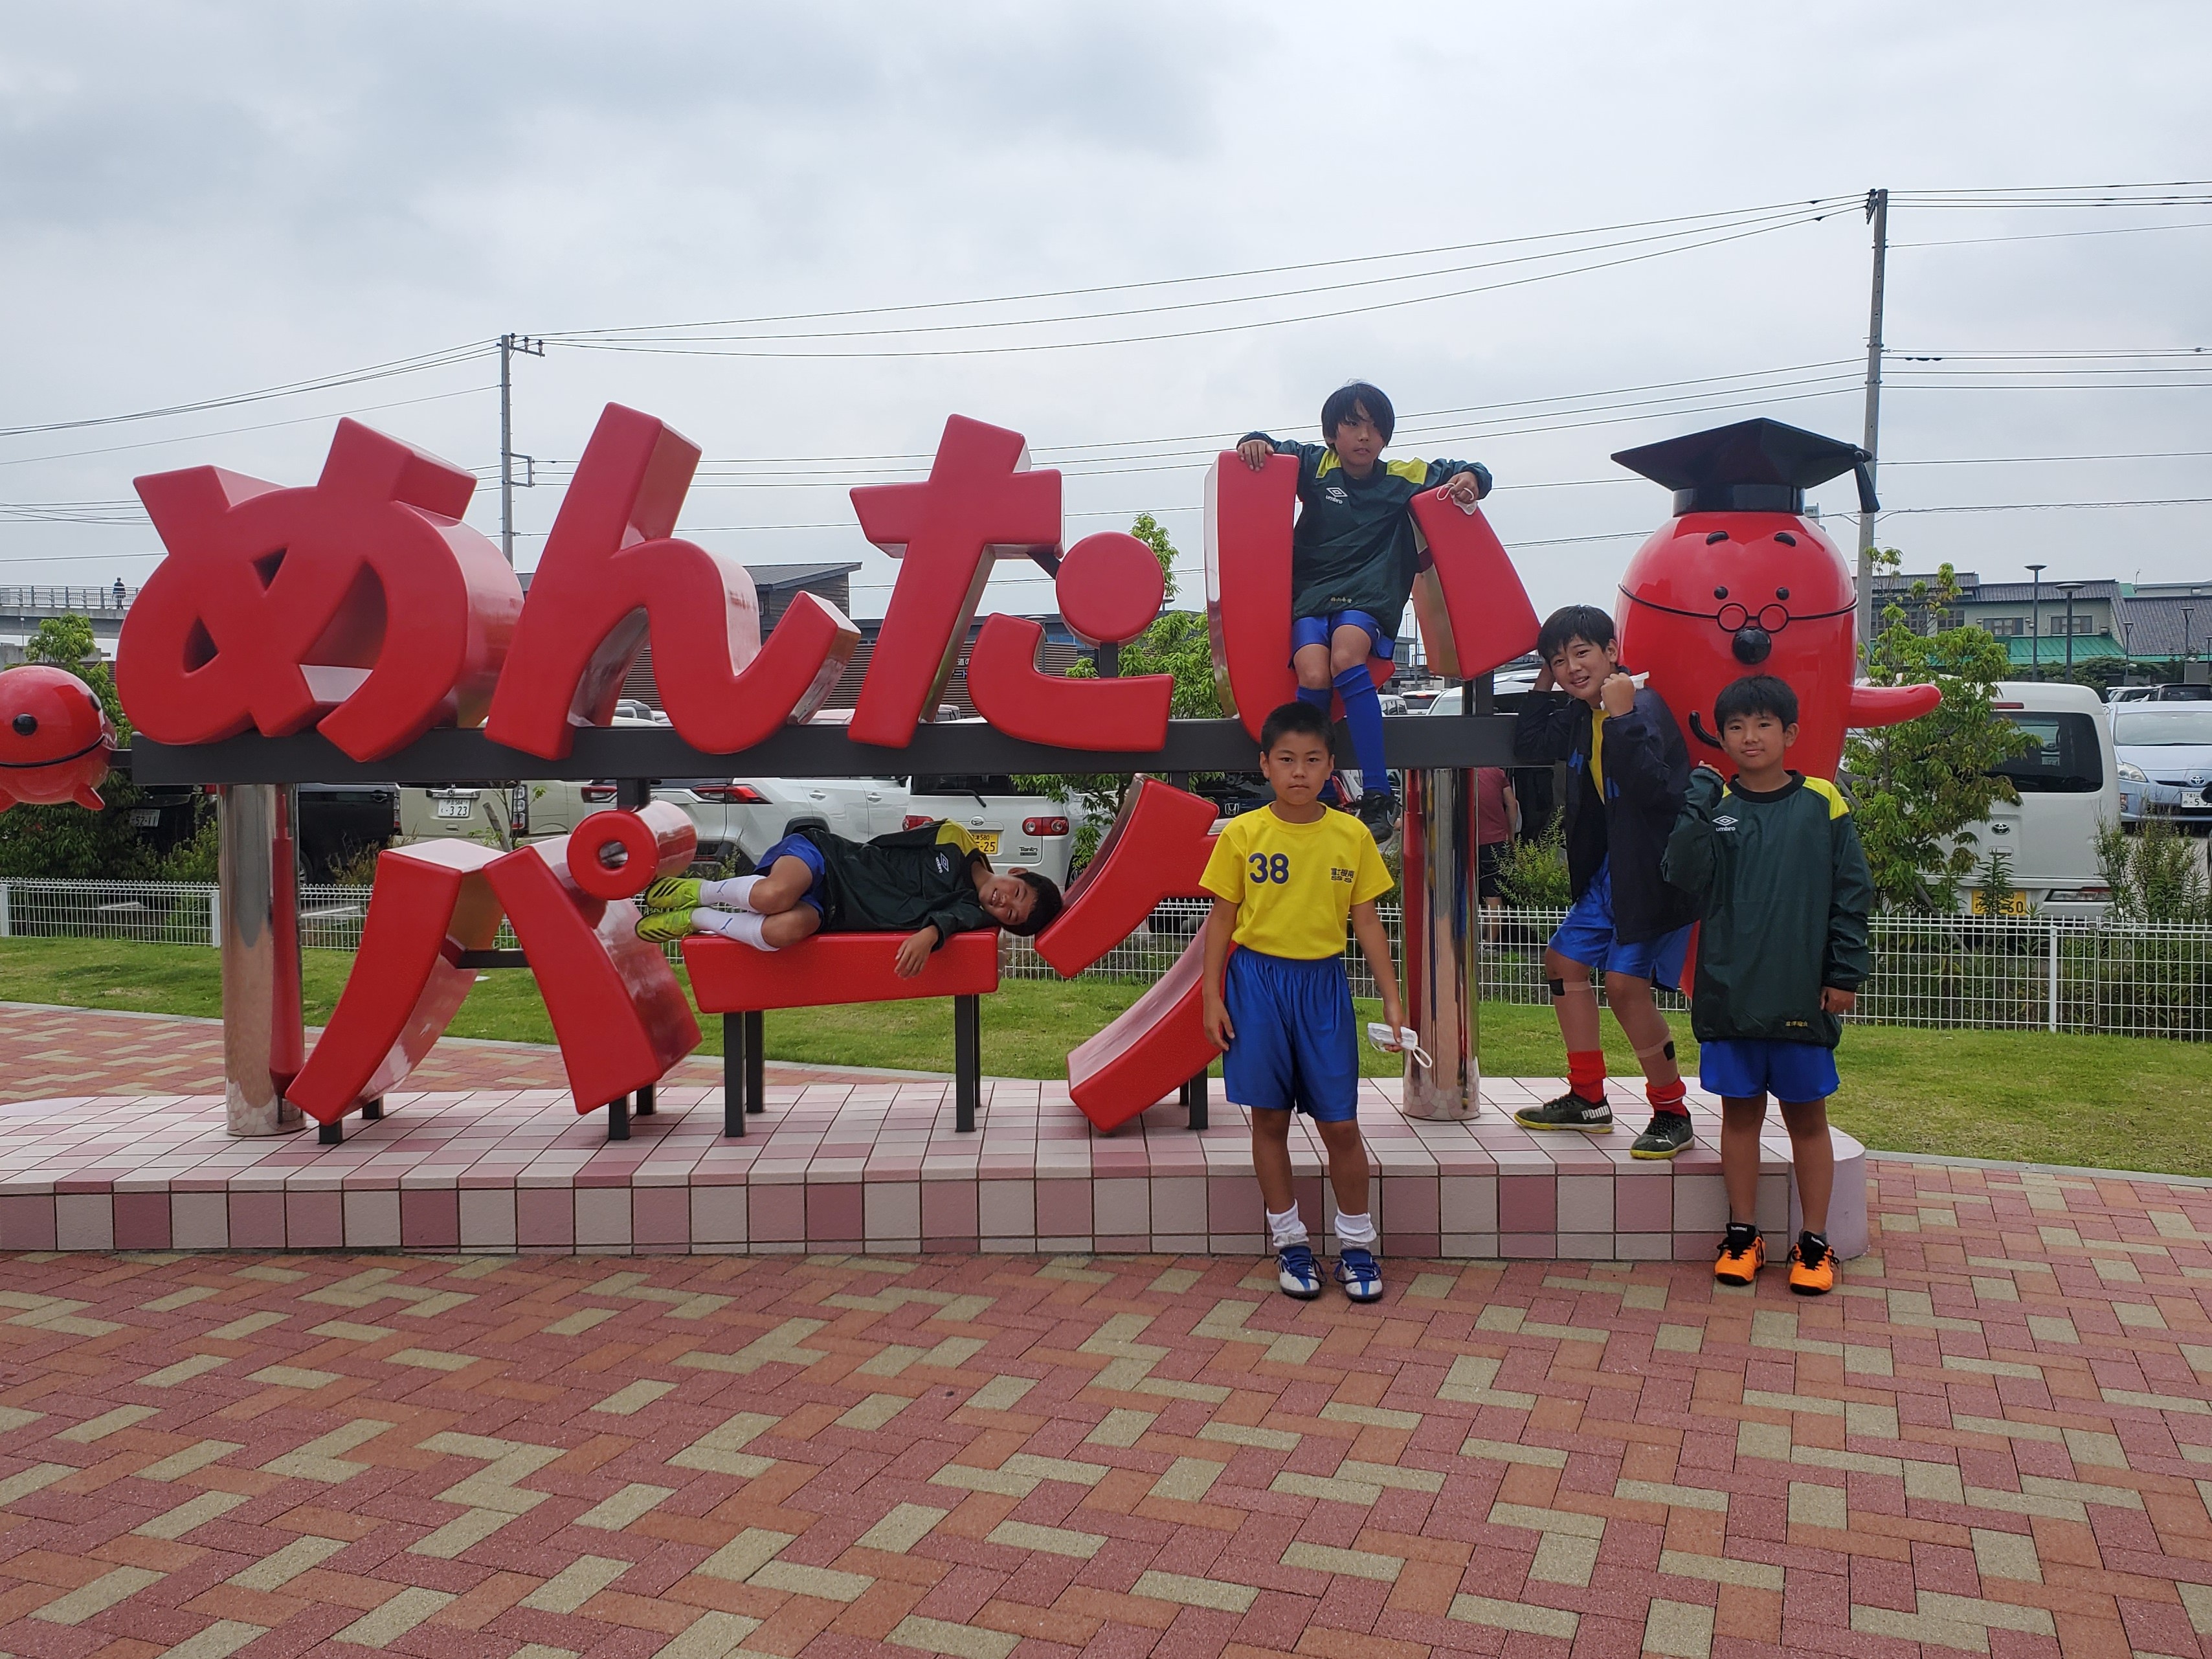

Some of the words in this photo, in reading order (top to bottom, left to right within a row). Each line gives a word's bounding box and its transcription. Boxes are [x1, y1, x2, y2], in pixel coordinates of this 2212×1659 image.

[1325, 495, 1343, 504] umbro
[116, 403, 1542, 763] めんたい
[1248, 852, 1289, 885] 38
[1581, 1105, 1611, 1120] PUMA
